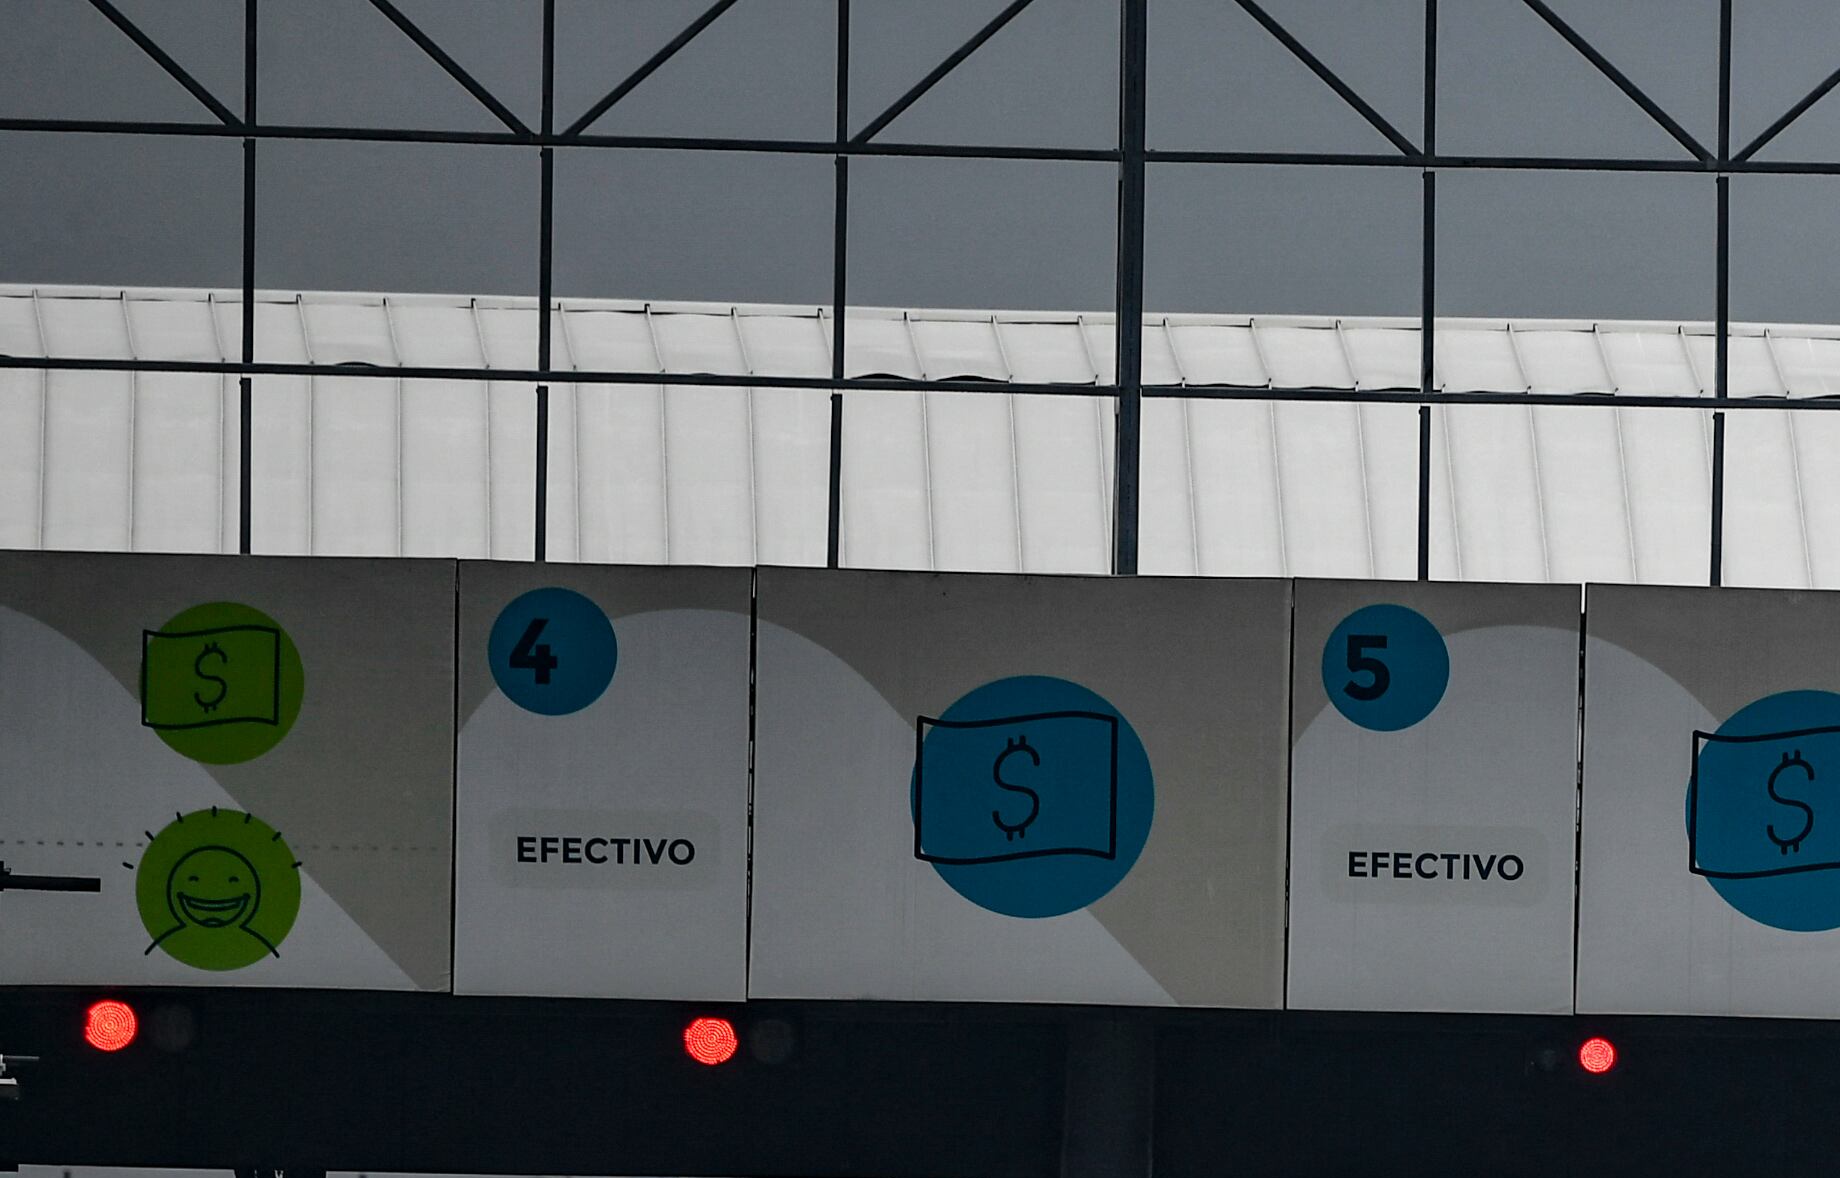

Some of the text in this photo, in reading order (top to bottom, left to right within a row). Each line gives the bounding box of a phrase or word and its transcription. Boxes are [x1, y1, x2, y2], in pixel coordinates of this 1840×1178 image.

[508, 618, 559, 685] 4
[1343, 634, 1391, 702] 5
[516, 835, 696, 866] EFECTIVO
[1348, 851, 1524, 881] EFECTIVO
